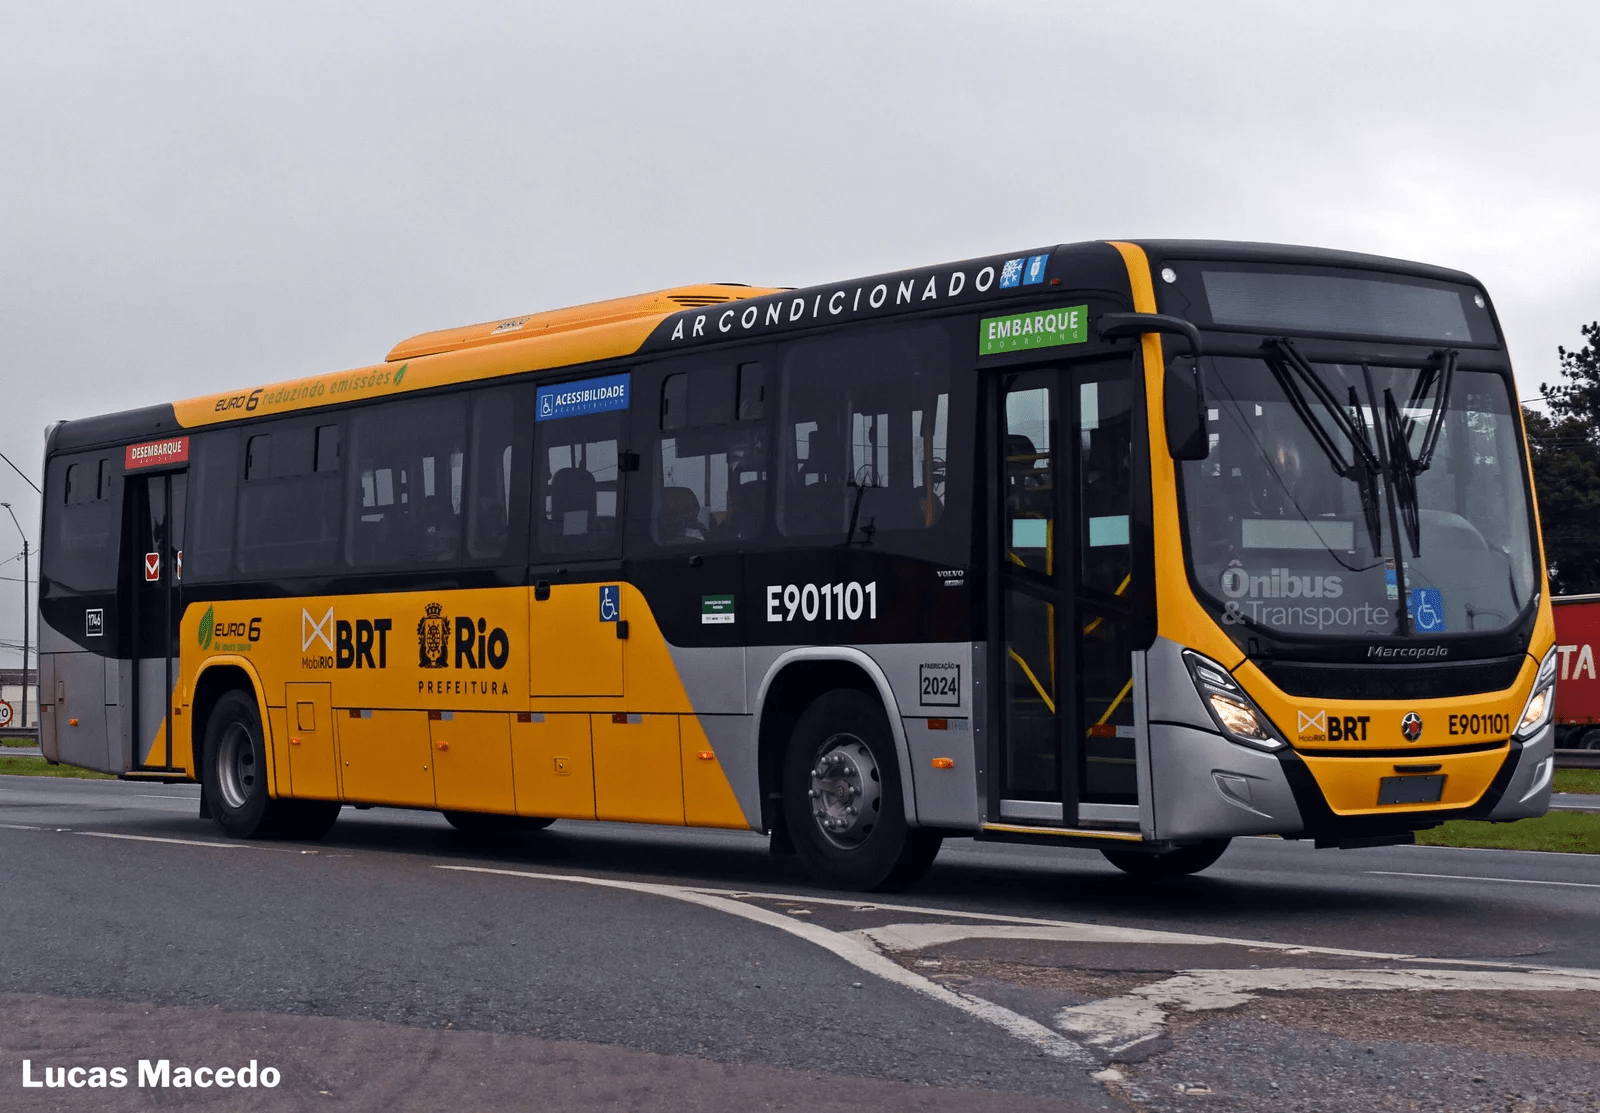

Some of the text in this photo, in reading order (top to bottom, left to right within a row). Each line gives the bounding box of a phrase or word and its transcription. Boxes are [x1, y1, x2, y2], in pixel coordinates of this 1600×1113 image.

[671, 266, 995, 341] AR CONDICIONADO
[988, 311, 1079, 340] EMBARQUE
[987, 331, 1078, 351] BOARDING
[214, 370, 392, 412] EURO 6 reduzindo emissões
[555, 384, 625, 406] ACESSIBILIDADE
[131, 440, 182, 460] DESEMBARQUE
[936, 569, 964, 577] VOLVO
[766, 581, 877, 622] E901101
[214, 616, 263, 642] EURO 6
[336, 618, 392, 669] BRT
[455, 616, 510, 670] Rio
[1367, 645, 1449, 659] Marcopolo
[301, 655, 334, 669] MobiRIO
[924, 661, 955, 671] FABRICAÇÃO
[418, 680, 509, 695] PREFEITURA
[922, 676, 957, 696] 2024
[1327, 715, 1371, 742] BRT
[1448, 713, 1510, 735] E901101
[1298, 734, 1326, 742] MobiRIO
